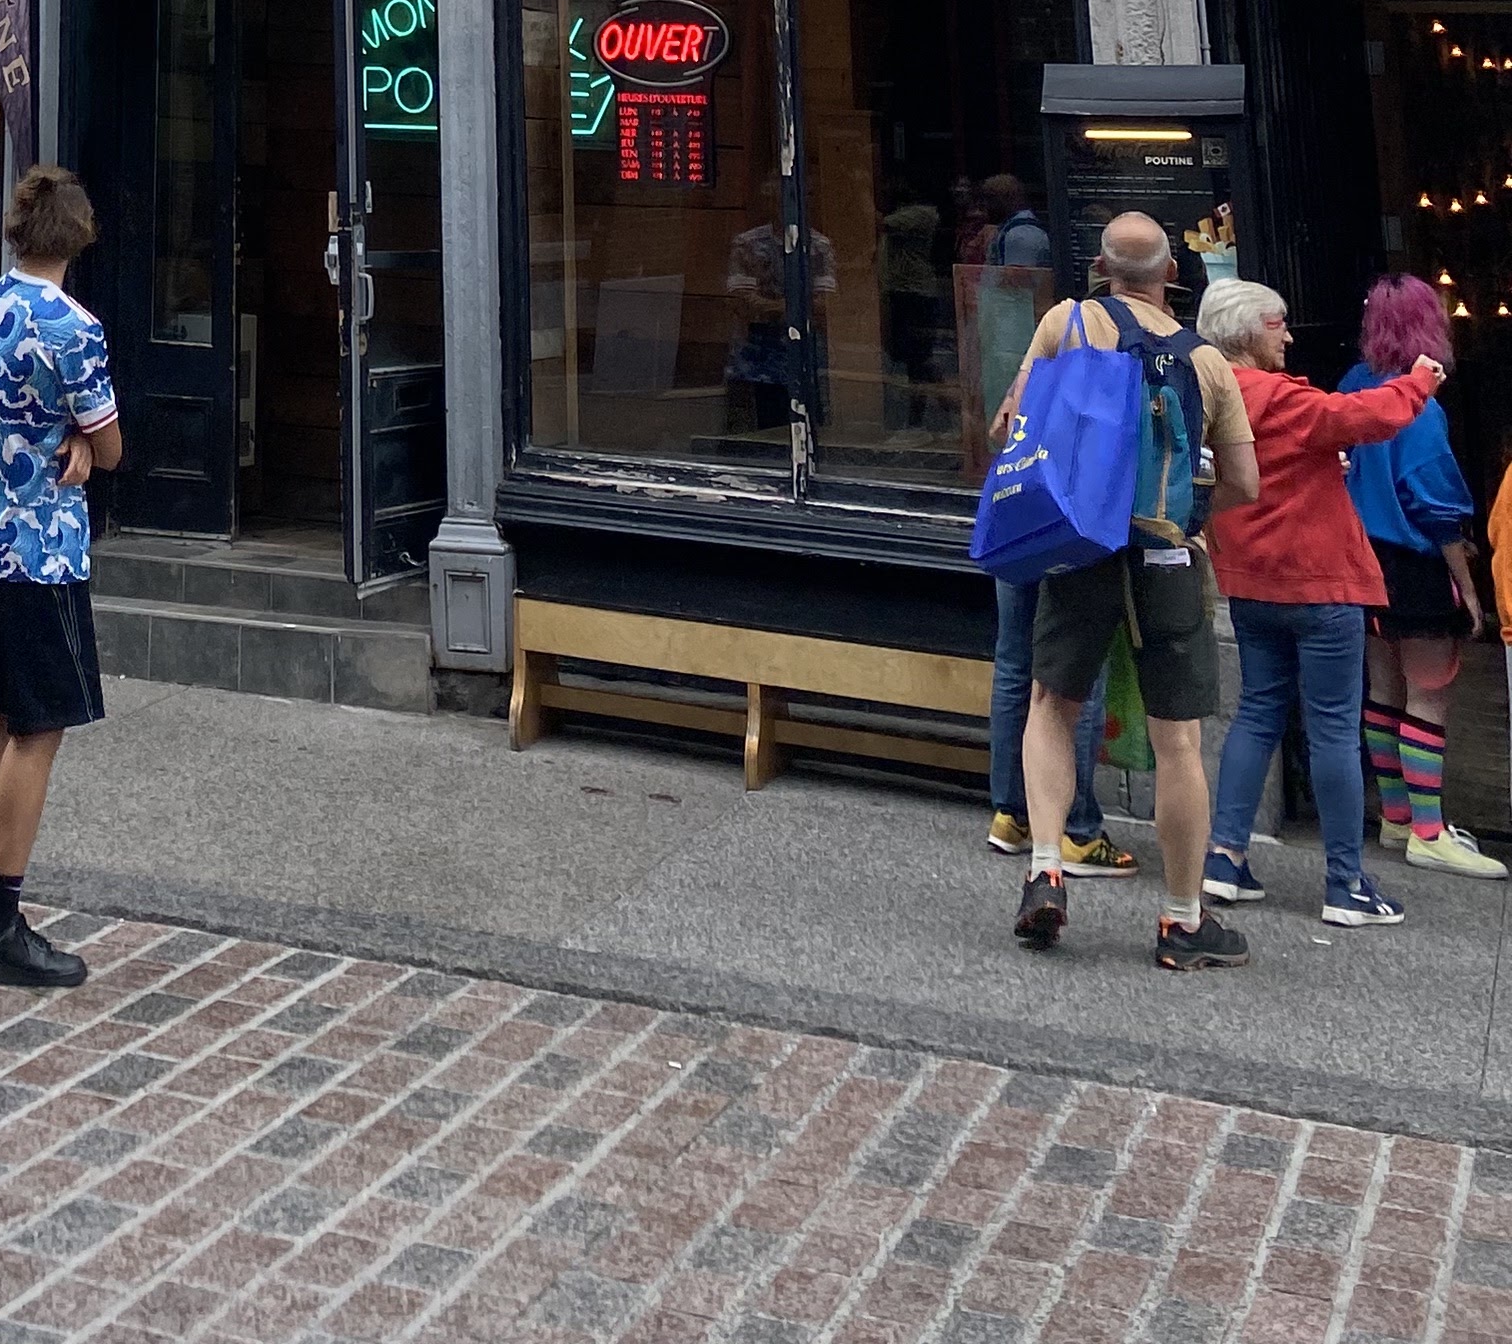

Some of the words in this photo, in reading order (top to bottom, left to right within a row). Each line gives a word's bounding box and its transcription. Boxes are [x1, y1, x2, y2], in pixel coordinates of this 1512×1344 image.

[600, 23, 720, 62] OUVERT
[617, 93, 648, 103] HEURES
[1144, 156, 1194, 166] POUTINE
